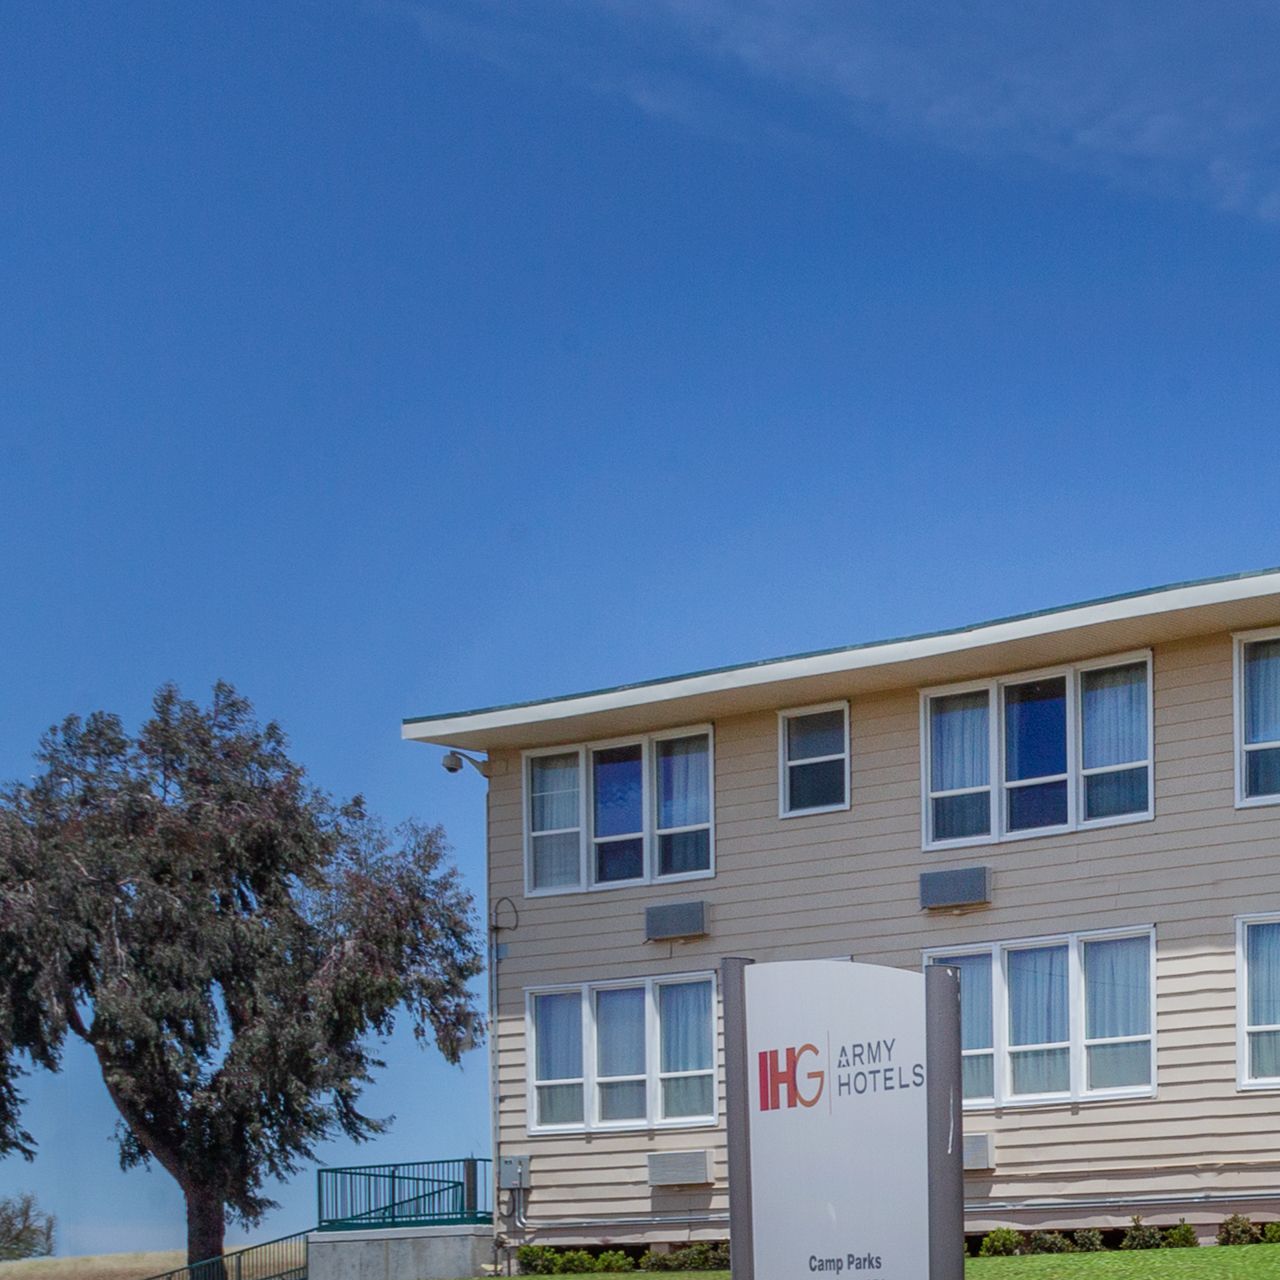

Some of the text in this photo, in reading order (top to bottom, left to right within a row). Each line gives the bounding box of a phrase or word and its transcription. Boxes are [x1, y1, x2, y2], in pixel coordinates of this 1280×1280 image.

[838, 1038, 896, 1068] ARMY
[758, 1043, 825, 1112] IHG
[838, 1063, 925, 1097] HOTELS
[809, 1253, 882, 1275] Camp Parks
